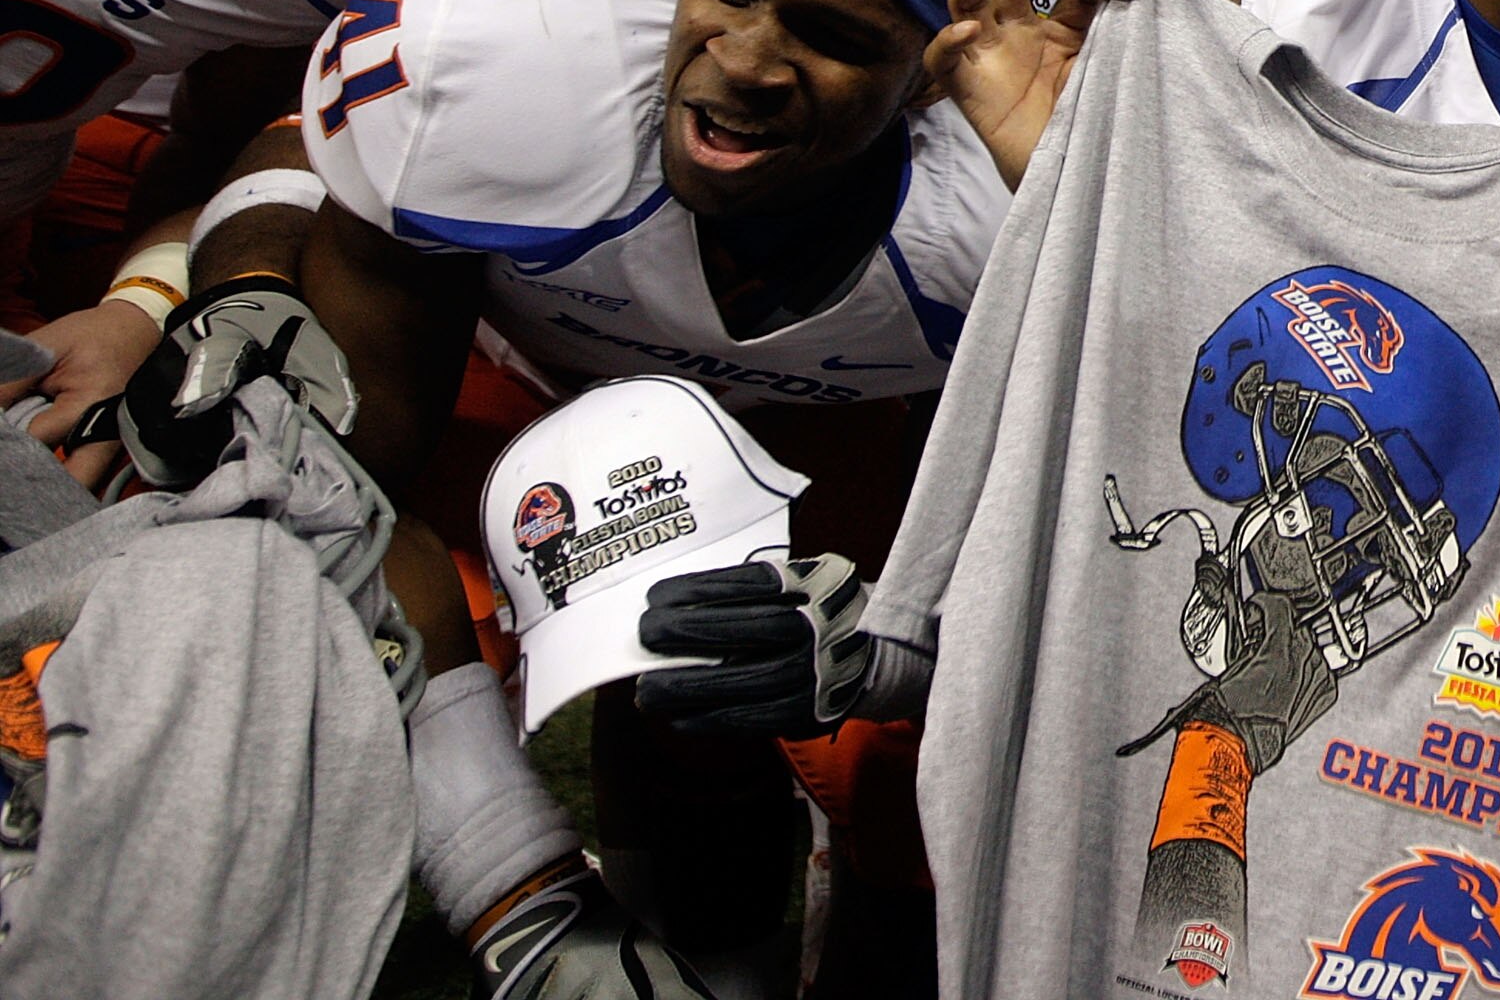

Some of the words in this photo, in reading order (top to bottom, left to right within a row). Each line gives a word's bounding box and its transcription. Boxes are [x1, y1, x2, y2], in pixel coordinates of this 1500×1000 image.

[1283, 289, 1352, 345] BOISE
[1294, 322, 1359, 384] STATE
[594, 470, 688, 520] Tostitos
[607, 456, 662, 488] 2010
[571, 514, 634, 554] FIESTA
[633, 494, 690, 526] BOWL
[539, 513, 698, 595] CHAMPIONS
[1448, 678, 1497, 704] FIESTA
[1184, 931, 1223, 956] BOWL
[1313, 952, 1455, 1000] BOISE
